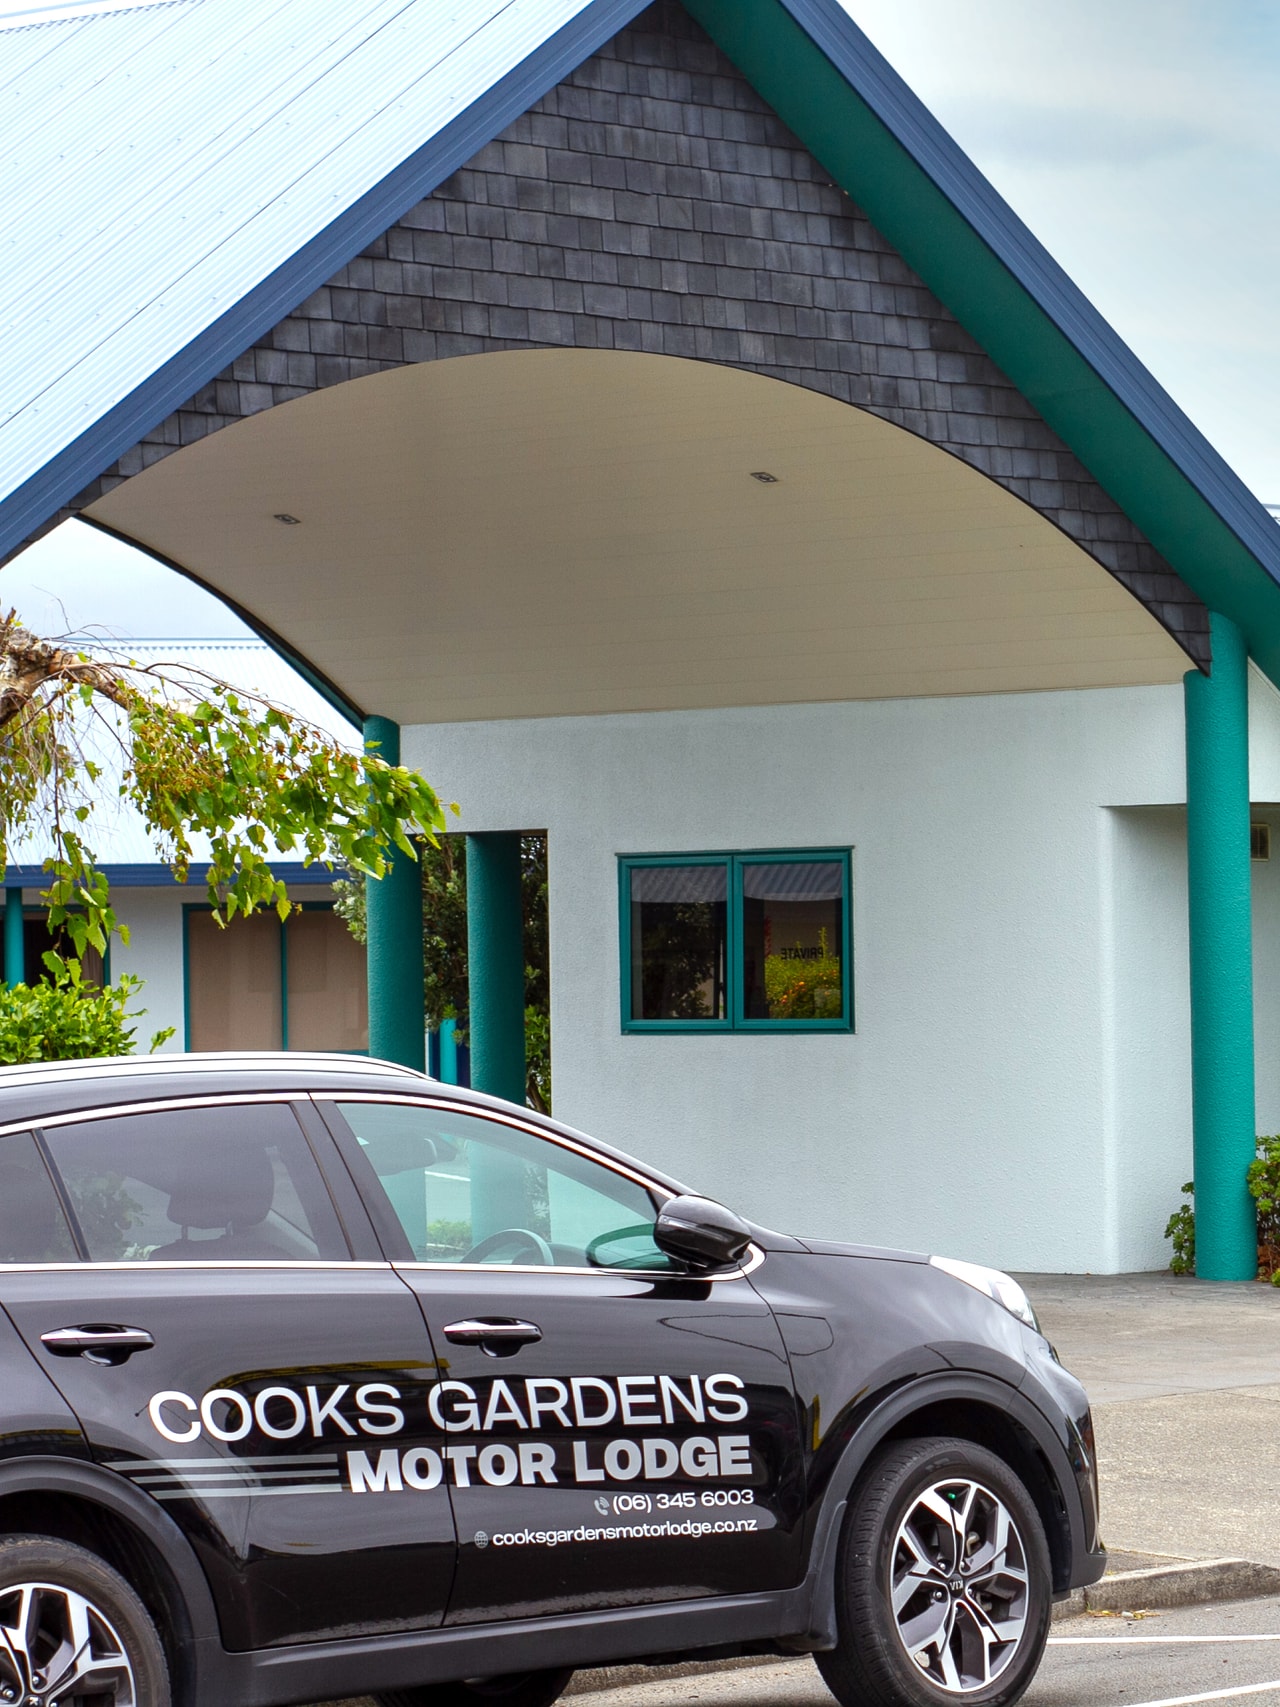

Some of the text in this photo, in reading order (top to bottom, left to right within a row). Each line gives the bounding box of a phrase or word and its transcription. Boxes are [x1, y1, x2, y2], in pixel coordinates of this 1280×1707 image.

[148, 1373, 749, 1443] COOKS GARDENS
[346, 1435, 753, 1493] MOTOR LODGE
[612, 1489, 754, 1515] (06) 345 6003
[492, 1518, 758, 1547] cooksgardensmotorlodge.co.nz
[949, 1580, 963, 1590] KIA
